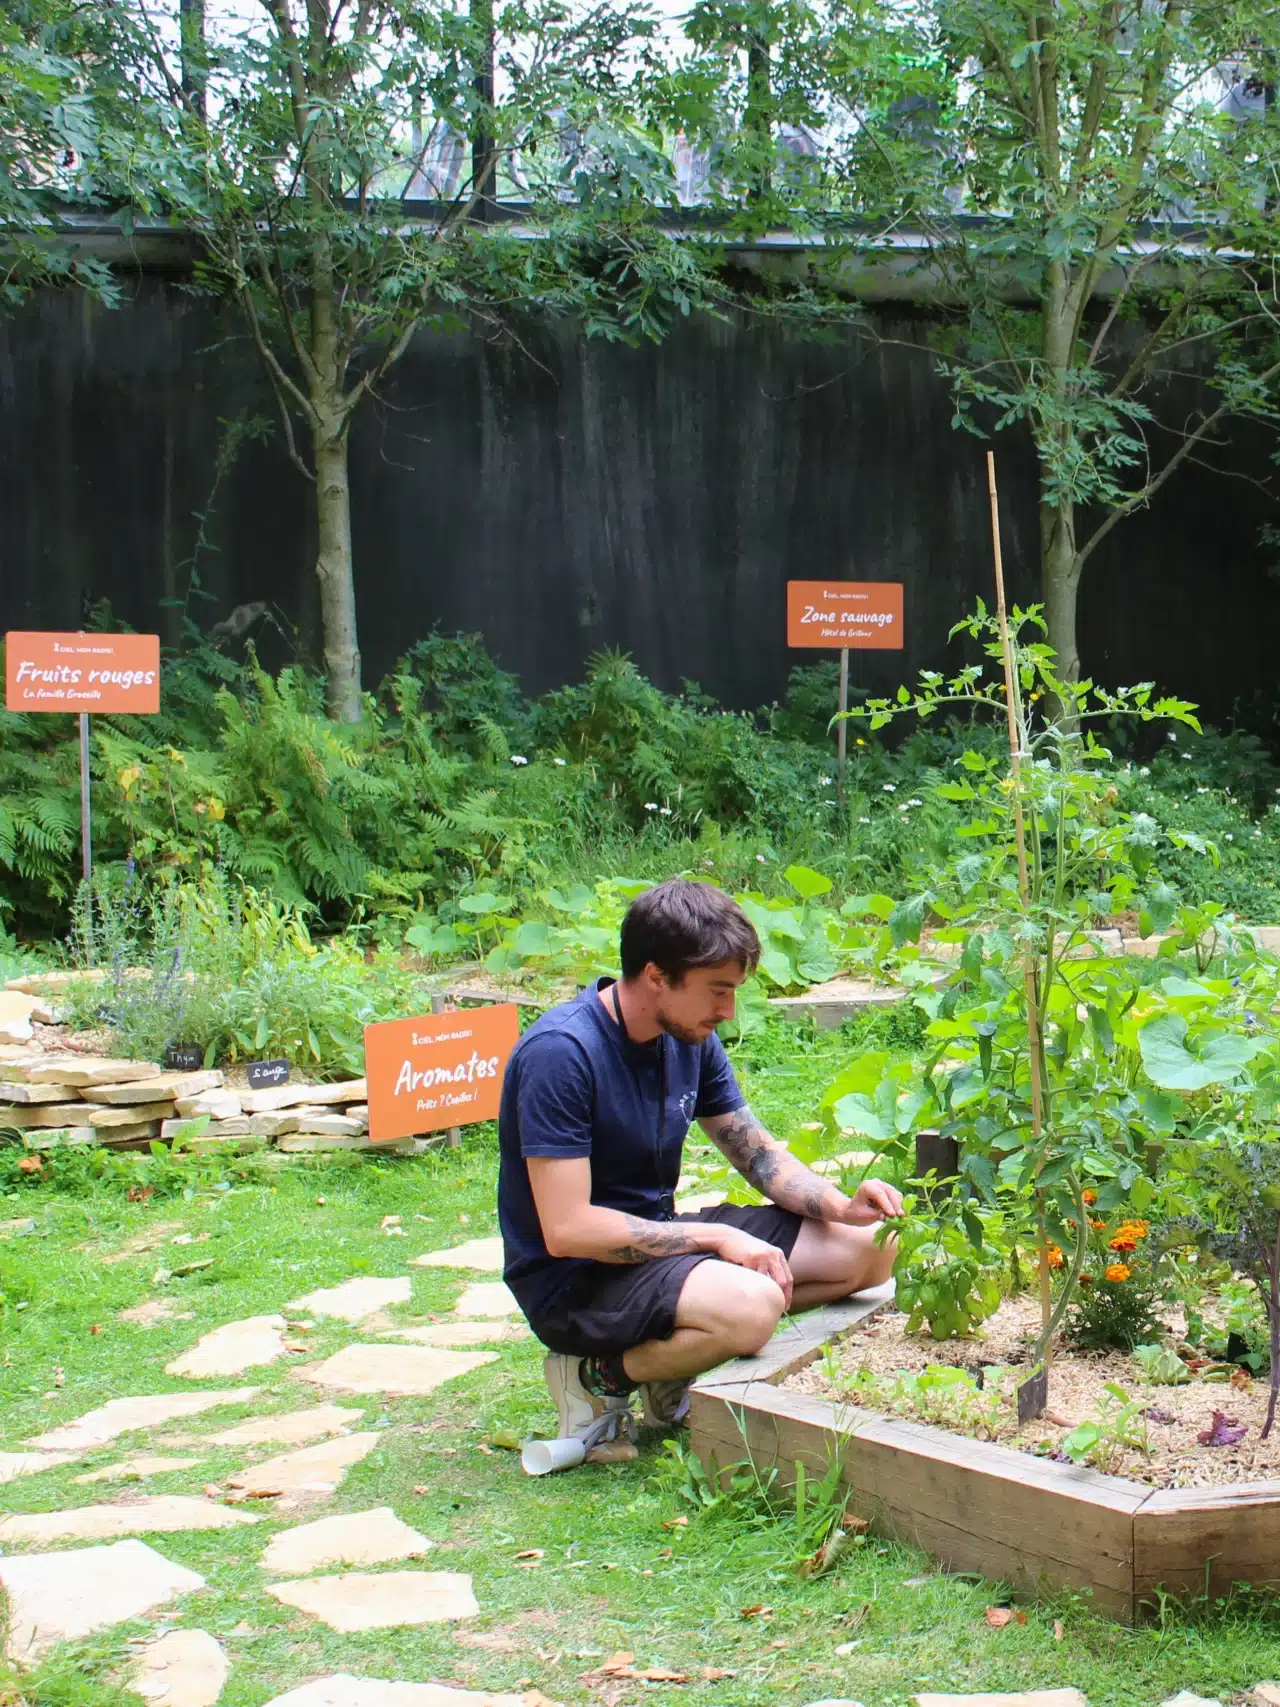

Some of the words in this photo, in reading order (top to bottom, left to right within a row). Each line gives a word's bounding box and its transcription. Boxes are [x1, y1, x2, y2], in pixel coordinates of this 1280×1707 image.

[800, 605, 836, 624] Zone
[840, 611, 893, 628] sauvage
[16, 660, 82, 683] Fruits
[88, 669, 156, 689] rouges
[23, 687, 35, 699] La
[169, 1051, 195, 1065] Thym
[393, 1049, 499, 1096] Aromates
